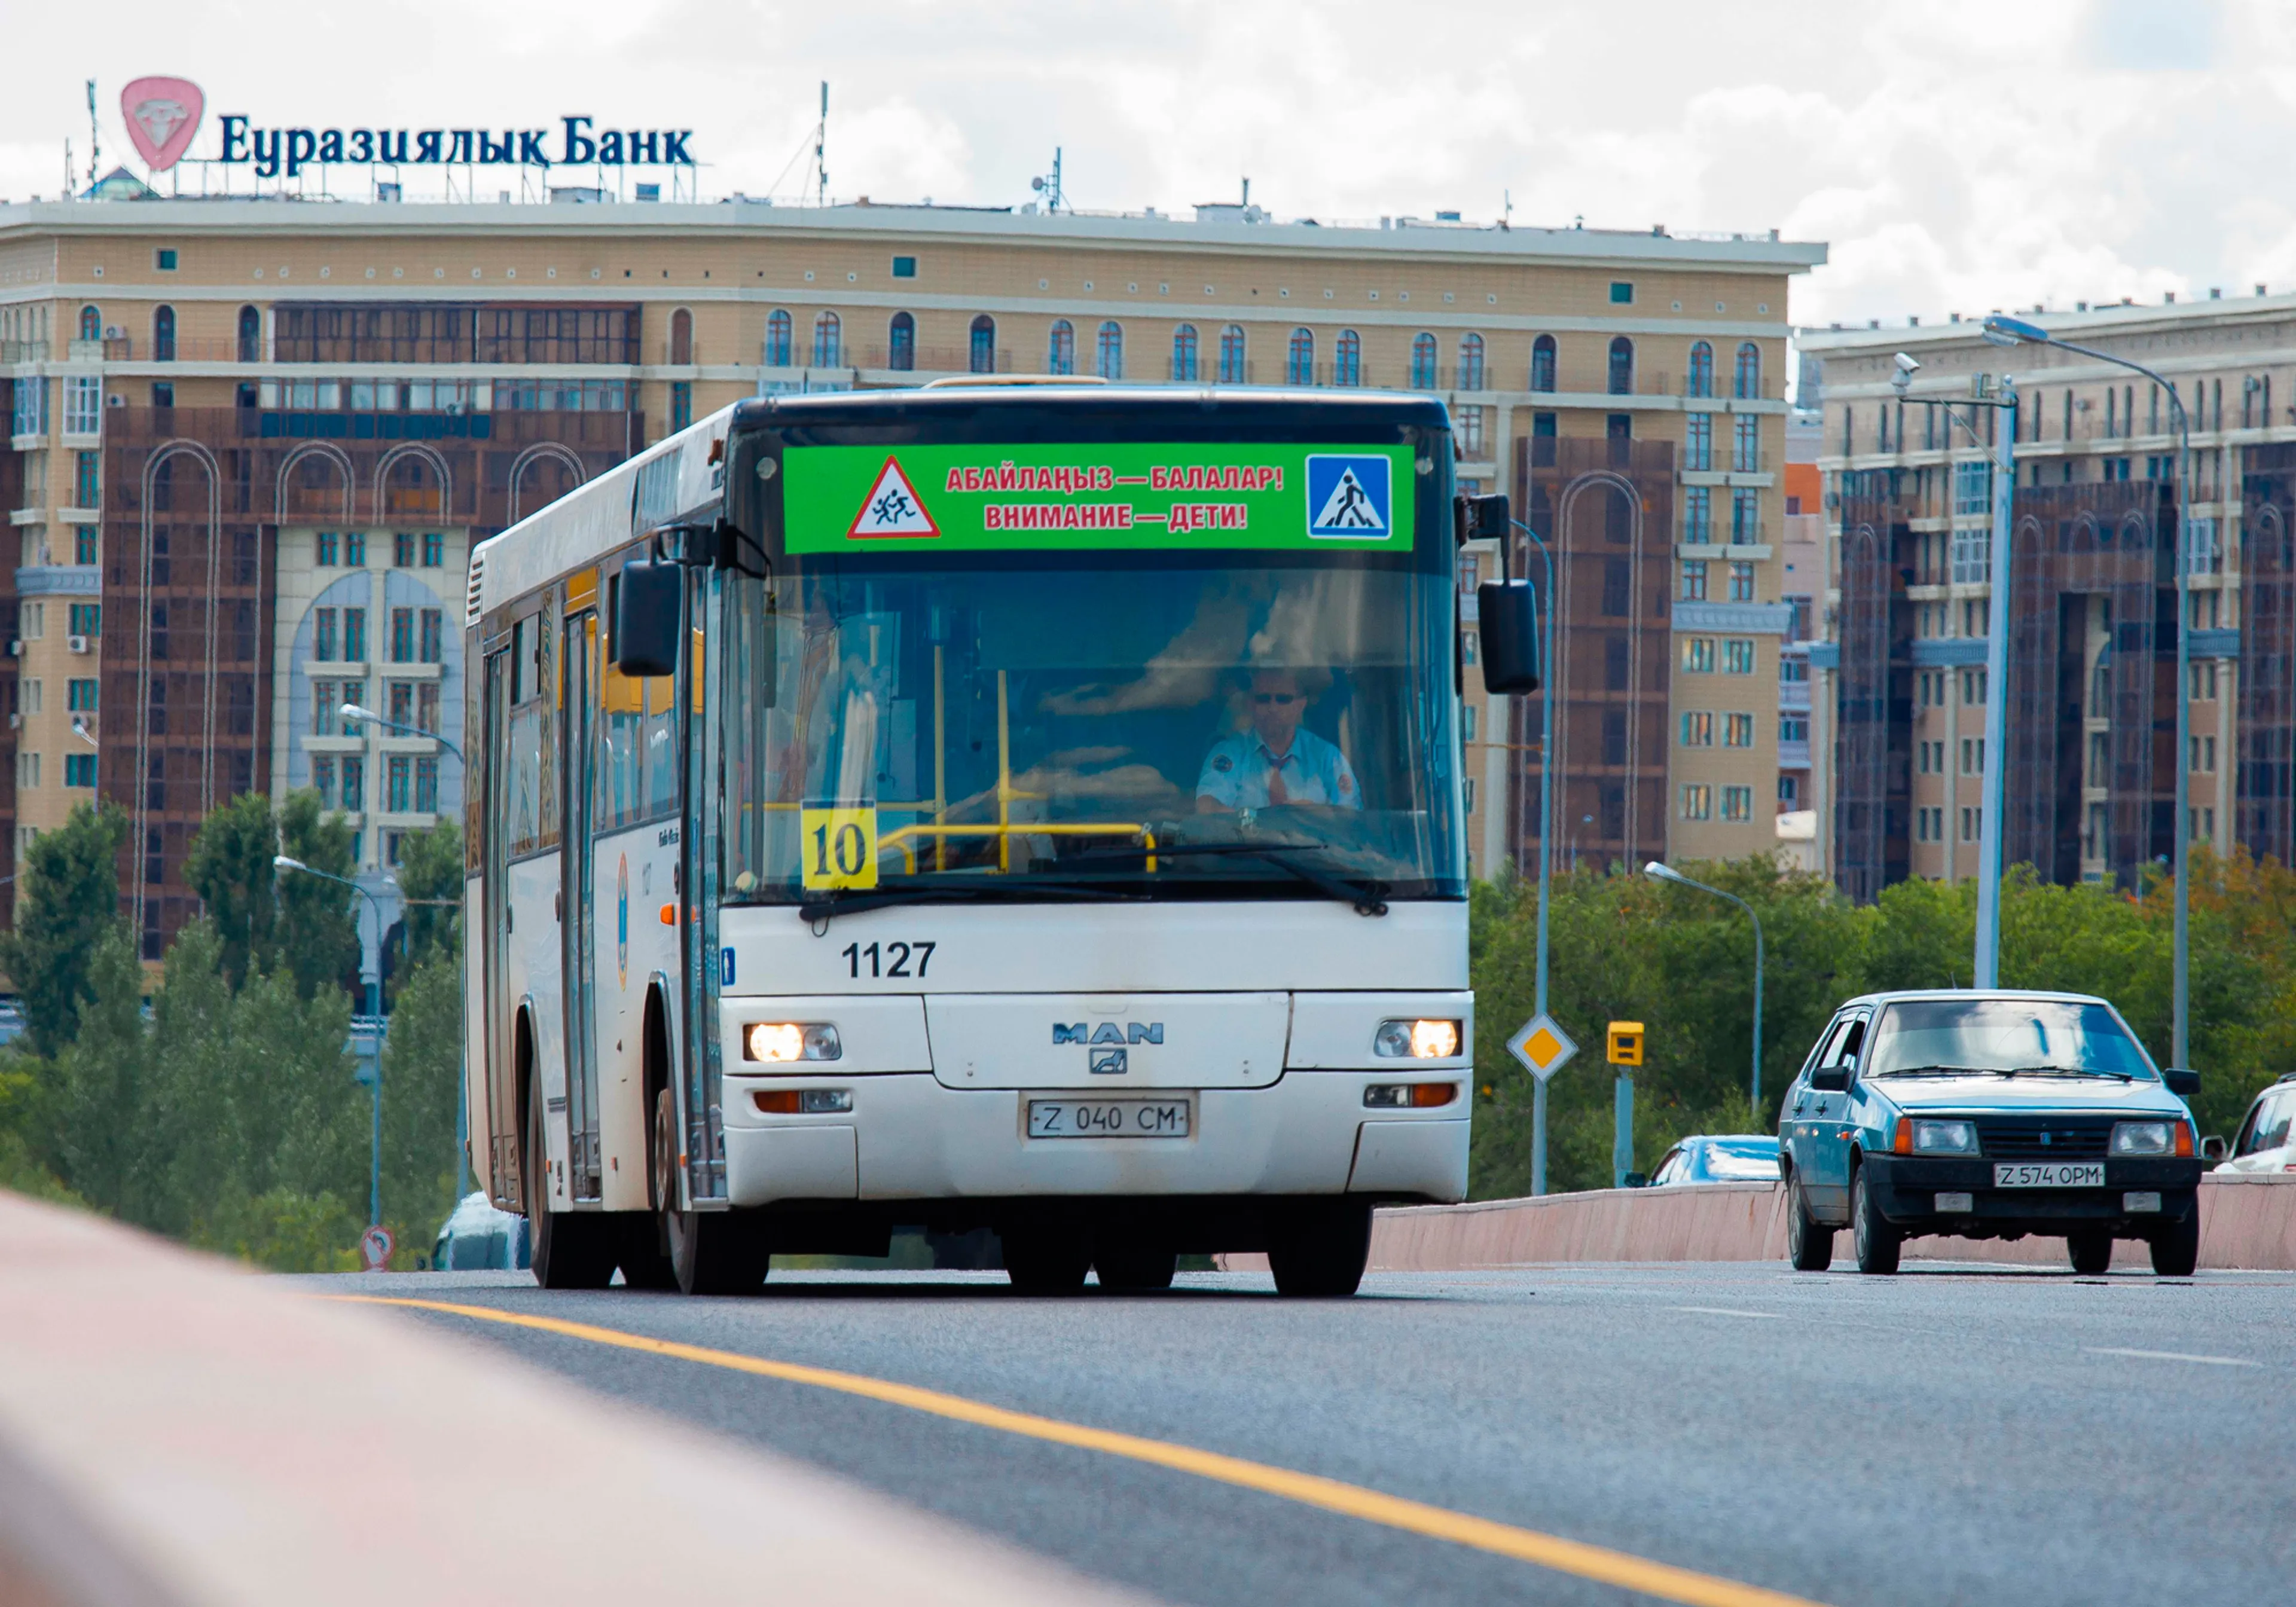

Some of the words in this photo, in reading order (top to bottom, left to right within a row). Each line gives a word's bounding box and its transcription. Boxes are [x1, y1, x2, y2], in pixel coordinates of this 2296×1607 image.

[218, 115, 550, 178] Еуразиялық
[560, 117, 693, 165] Банк
[812, 823, 867, 876] 10
[841, 941, 937, 978] 1127
[1052, 1022, 1164, 1045] MAN
[1043, 1106, 1062, 1131] Z
[1076, 1106, 1123, 1131] 040
[1137, 1105, 1177, 1131] CM
[1999, 1166, 2014, 1186] Z
[2019, 1166, 2053, 1186] 574
